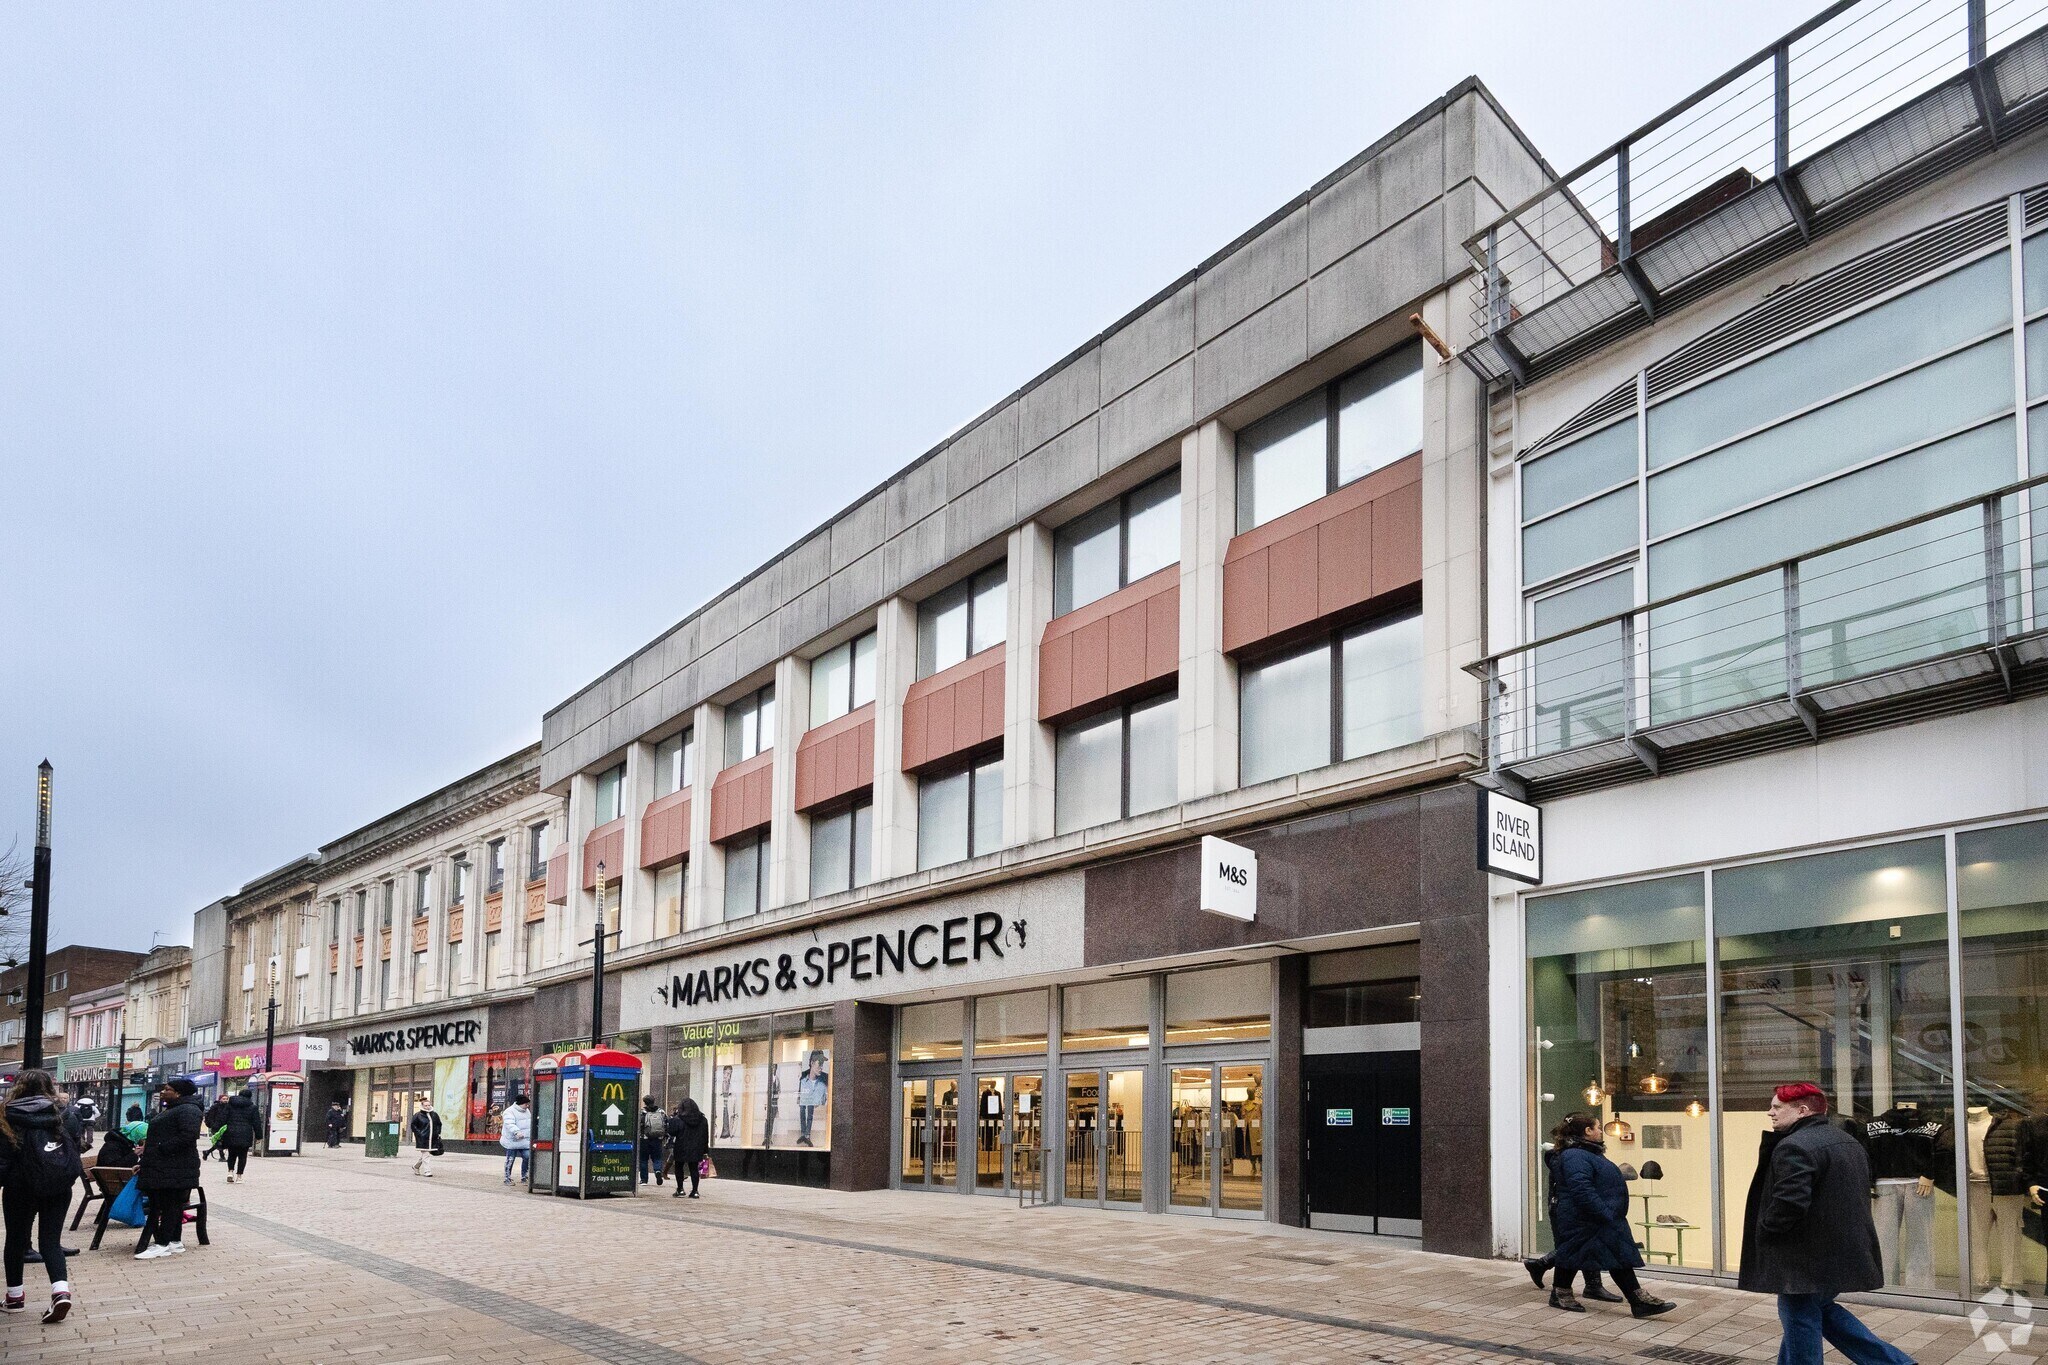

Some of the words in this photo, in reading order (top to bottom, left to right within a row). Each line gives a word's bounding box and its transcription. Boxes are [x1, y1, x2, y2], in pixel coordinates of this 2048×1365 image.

[1497, 811, 1530, 839] RIVER
[1493, 832, 1535, 861] ISLAND
[1220, 861, 1247, 886] M&S
[672, 957, 770, 1008] MARKS
[775, 953, 797, 991] &
[803, 911, 1004, 987] SPENCER
[353, 1031, 395, 1055] MARKS
[396, 1029, 405, 1051] &
[406, 1020, 476, 1050] SPENCER
[683, 1025, 713, 1040] Value
[718, 1022, 740, 1041] you
[553, 1041, 574, 1053] Value
[682, 1046, 700, 1059] can
[234, 1055, 251, 1070] Cards
[63, 1068, 78, 1082] LUPO
[79, 1067, 107, 1081] LOUNGE
[603, 1157, 620, 1165] Open
[613, 1166, 630, 1174] 11pm
[596, 1175, 609, 1183] days
